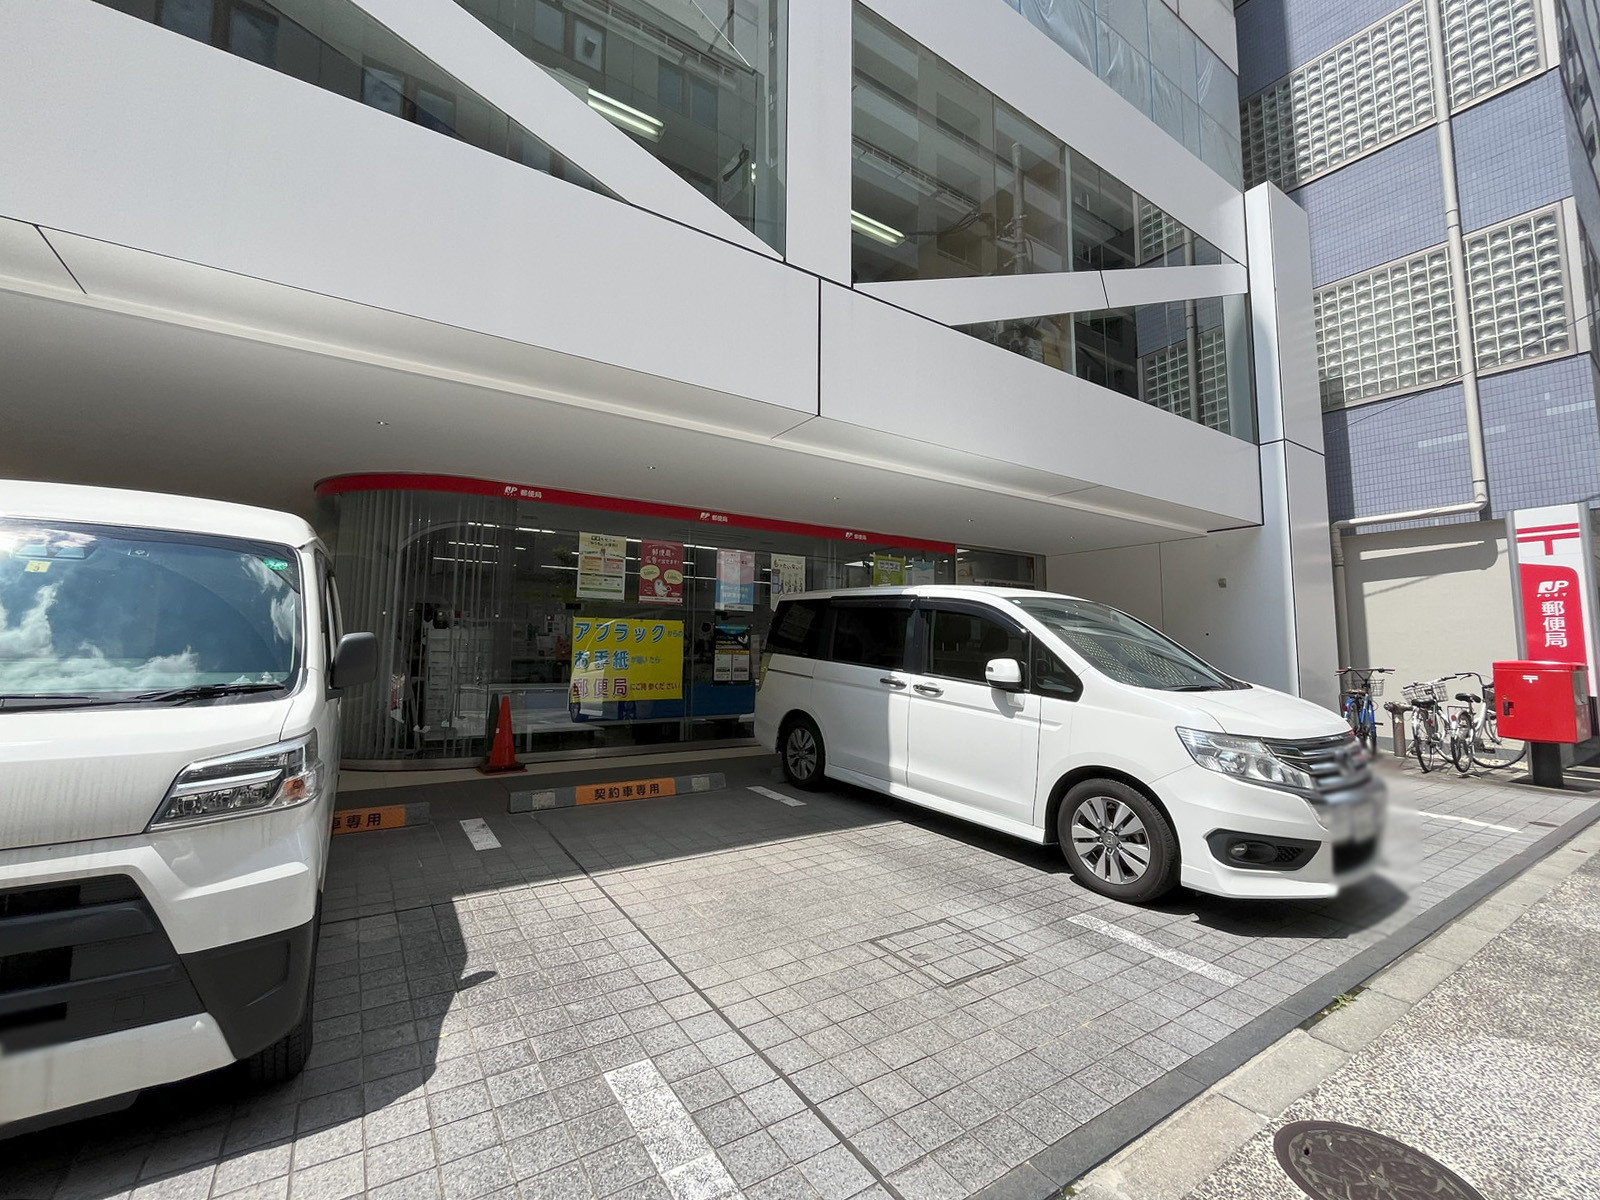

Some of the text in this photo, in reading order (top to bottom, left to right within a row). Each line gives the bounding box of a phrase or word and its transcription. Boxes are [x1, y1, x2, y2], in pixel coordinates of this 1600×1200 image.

[520, 489, 542, 499] 郵便局
[1538, 580, 1569, 593] JP
[1541, 601, 1568, 648] 郵便局
[594, 783, 660, 801] 契約車専用
